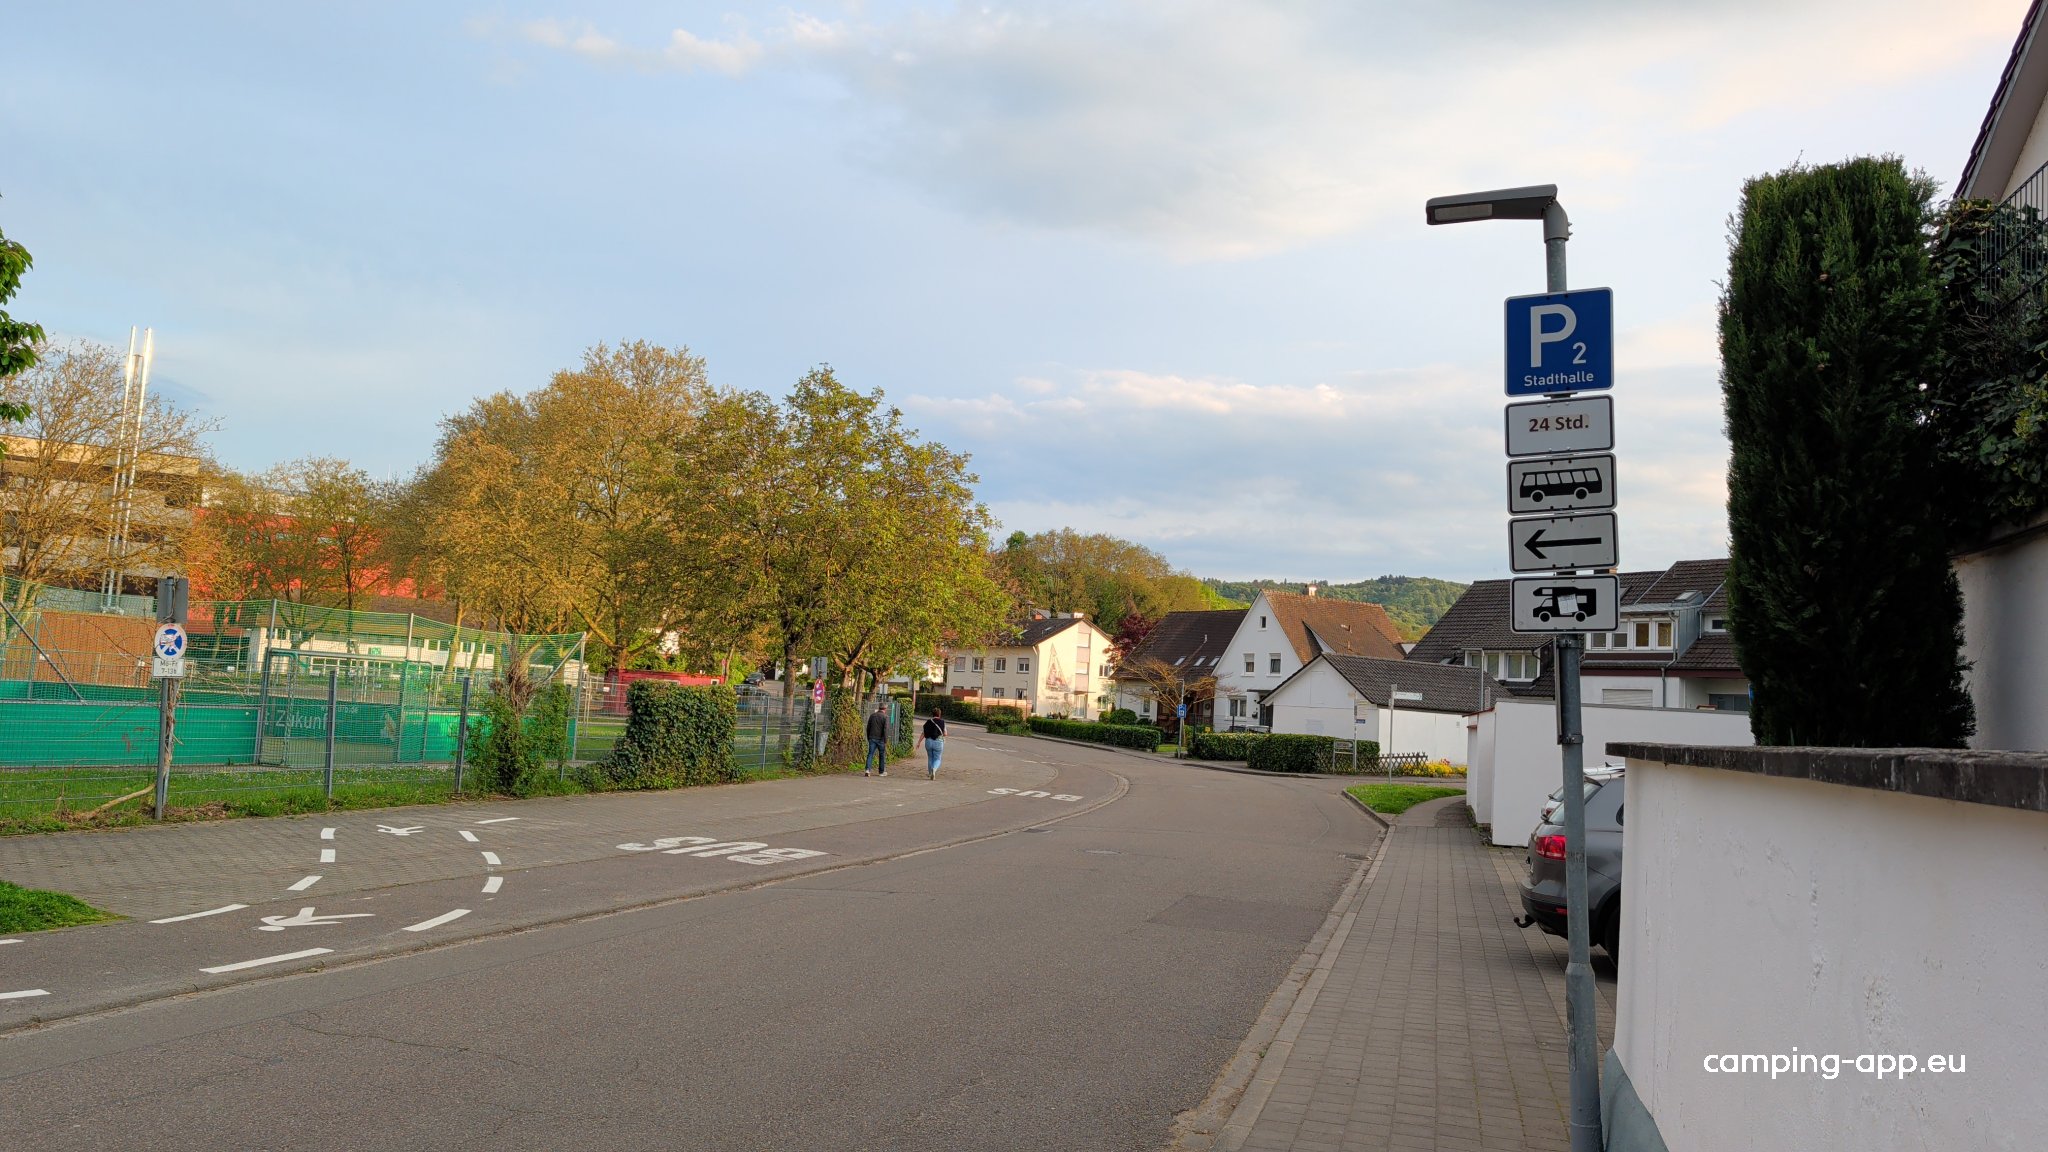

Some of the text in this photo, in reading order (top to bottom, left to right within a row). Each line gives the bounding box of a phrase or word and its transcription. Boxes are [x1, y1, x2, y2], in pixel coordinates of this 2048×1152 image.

[1530, 303, 1587, 368] P 2
[1524, 370, 1594, 387] Stadthalle
[1529, 414, 1589, 432] 24 Std.
[275, 709, 329, 731] Zukunf
